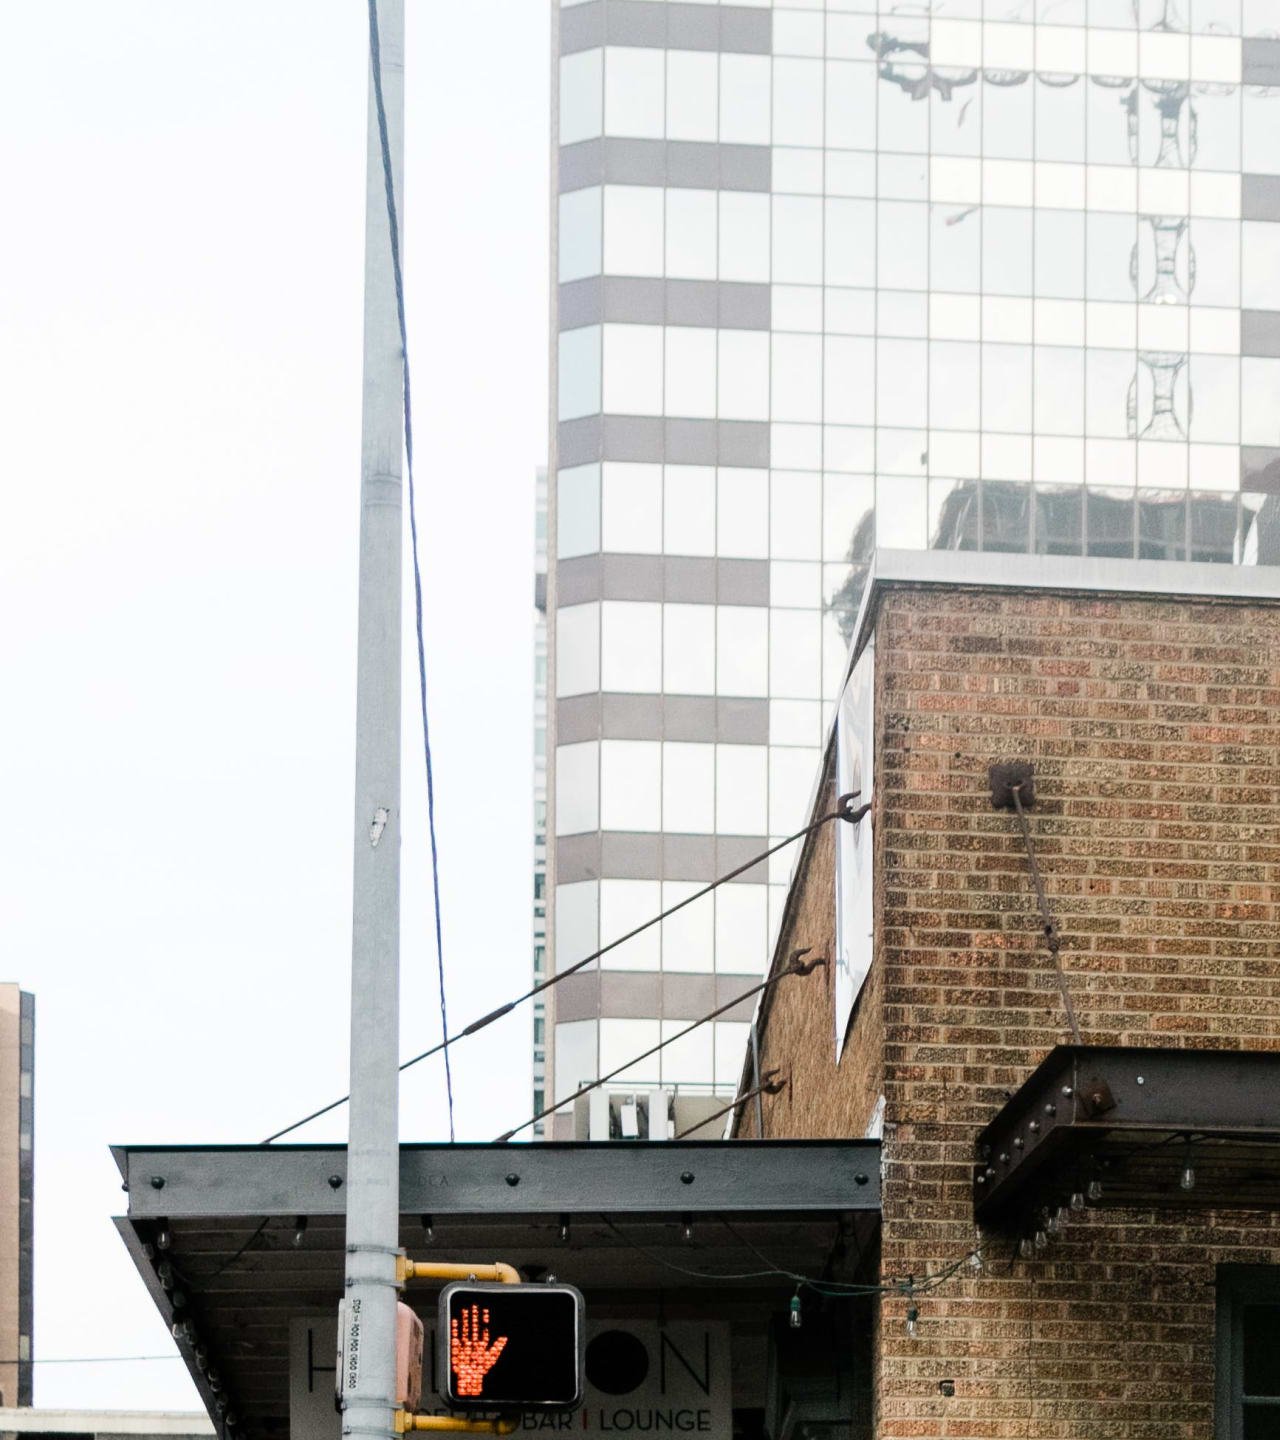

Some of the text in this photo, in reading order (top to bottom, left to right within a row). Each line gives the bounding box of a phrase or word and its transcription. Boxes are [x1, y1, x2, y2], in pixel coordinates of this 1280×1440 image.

[353, 1299, 361, 1314] STOP
[351, 1324, 360, 1336] POO
[350, 1339, 359, 1352] POO
[521, 1410, 574, 1431] BAR
[600, 1409, 711, 1431] LOUNGE
